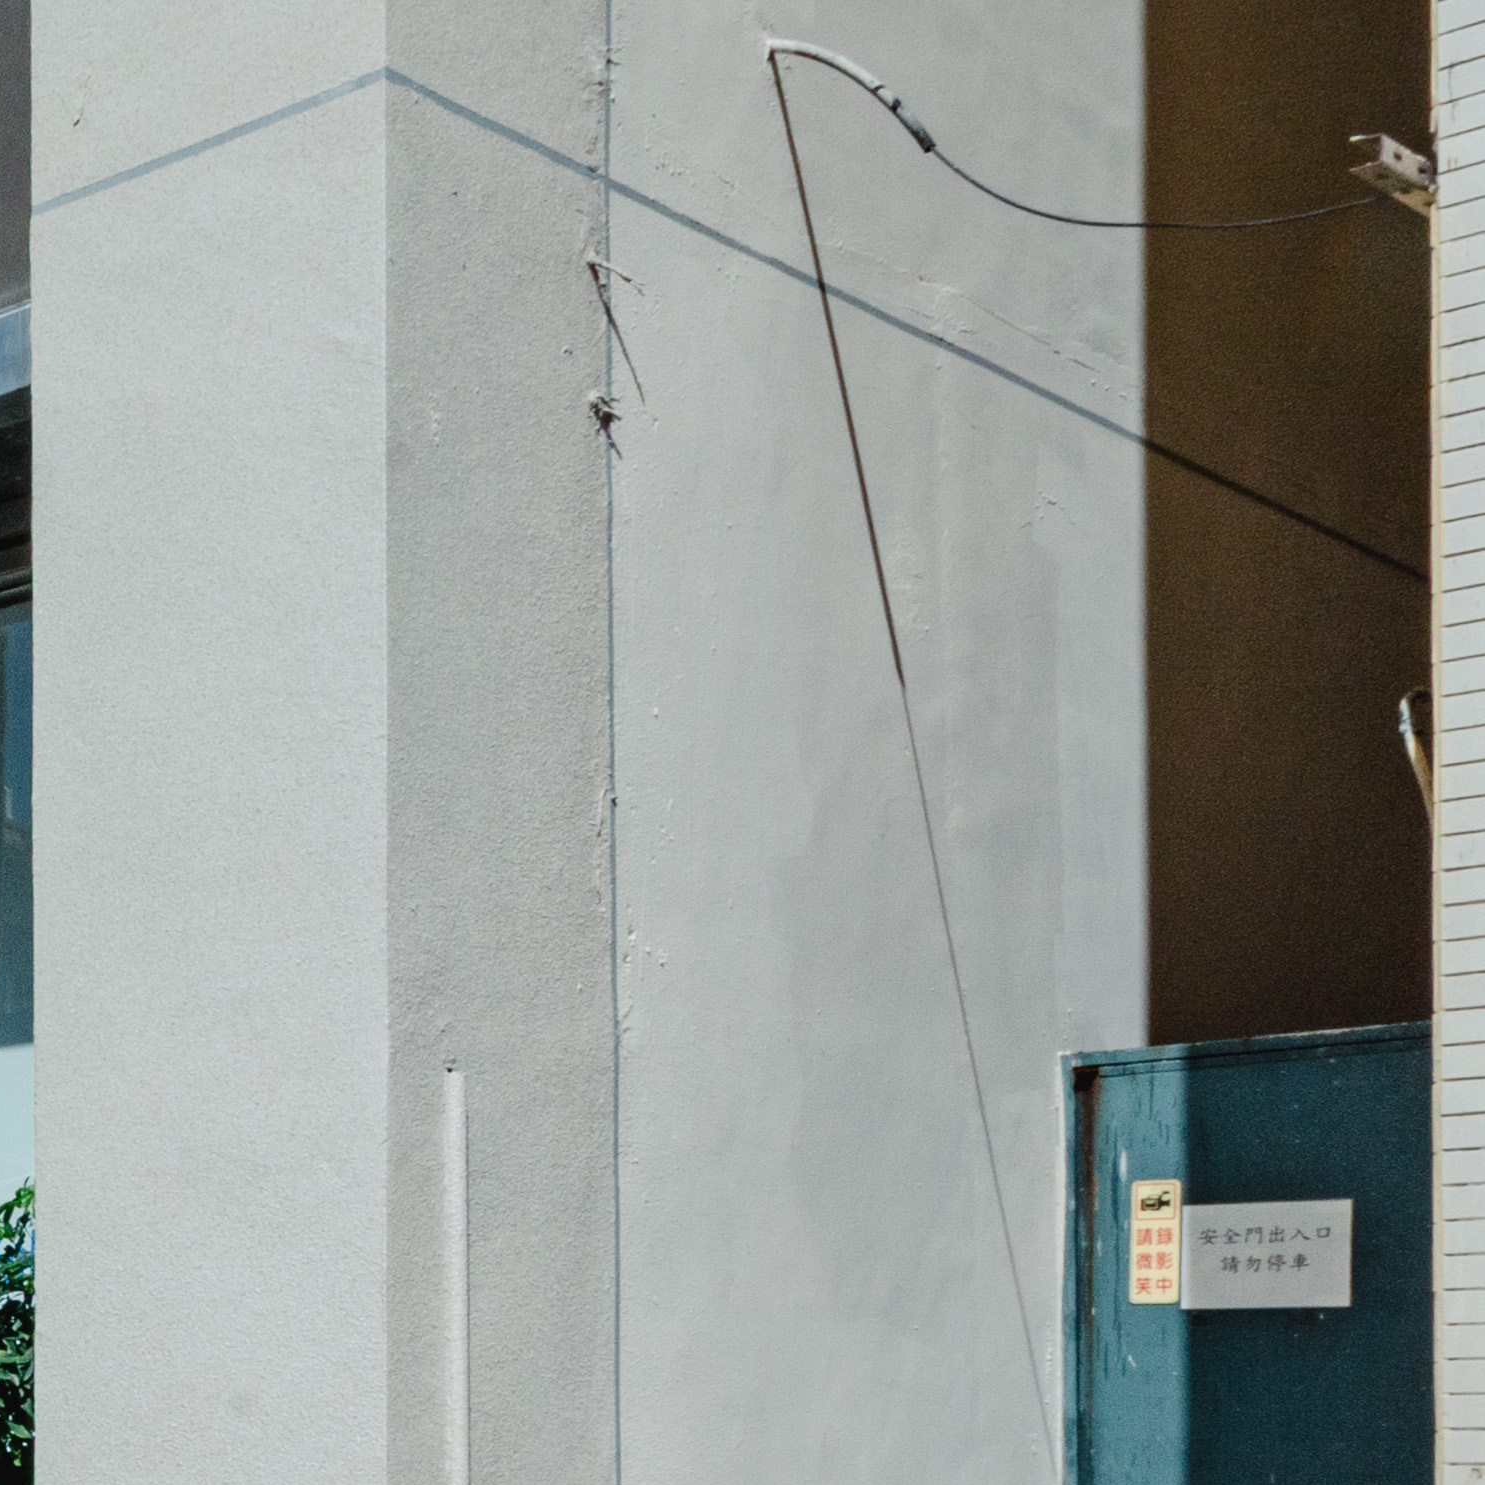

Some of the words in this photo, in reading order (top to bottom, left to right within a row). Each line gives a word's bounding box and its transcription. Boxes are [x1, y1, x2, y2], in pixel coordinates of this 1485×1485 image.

[1198, 1226, 1331, 1246] 安全門出入口
[1135, 1228, 1153, 1296] 請微笑
[1156, 1227, 1173, 1295] 錄影中
[1220, 1253, 1310, 1274] 請勿停車
